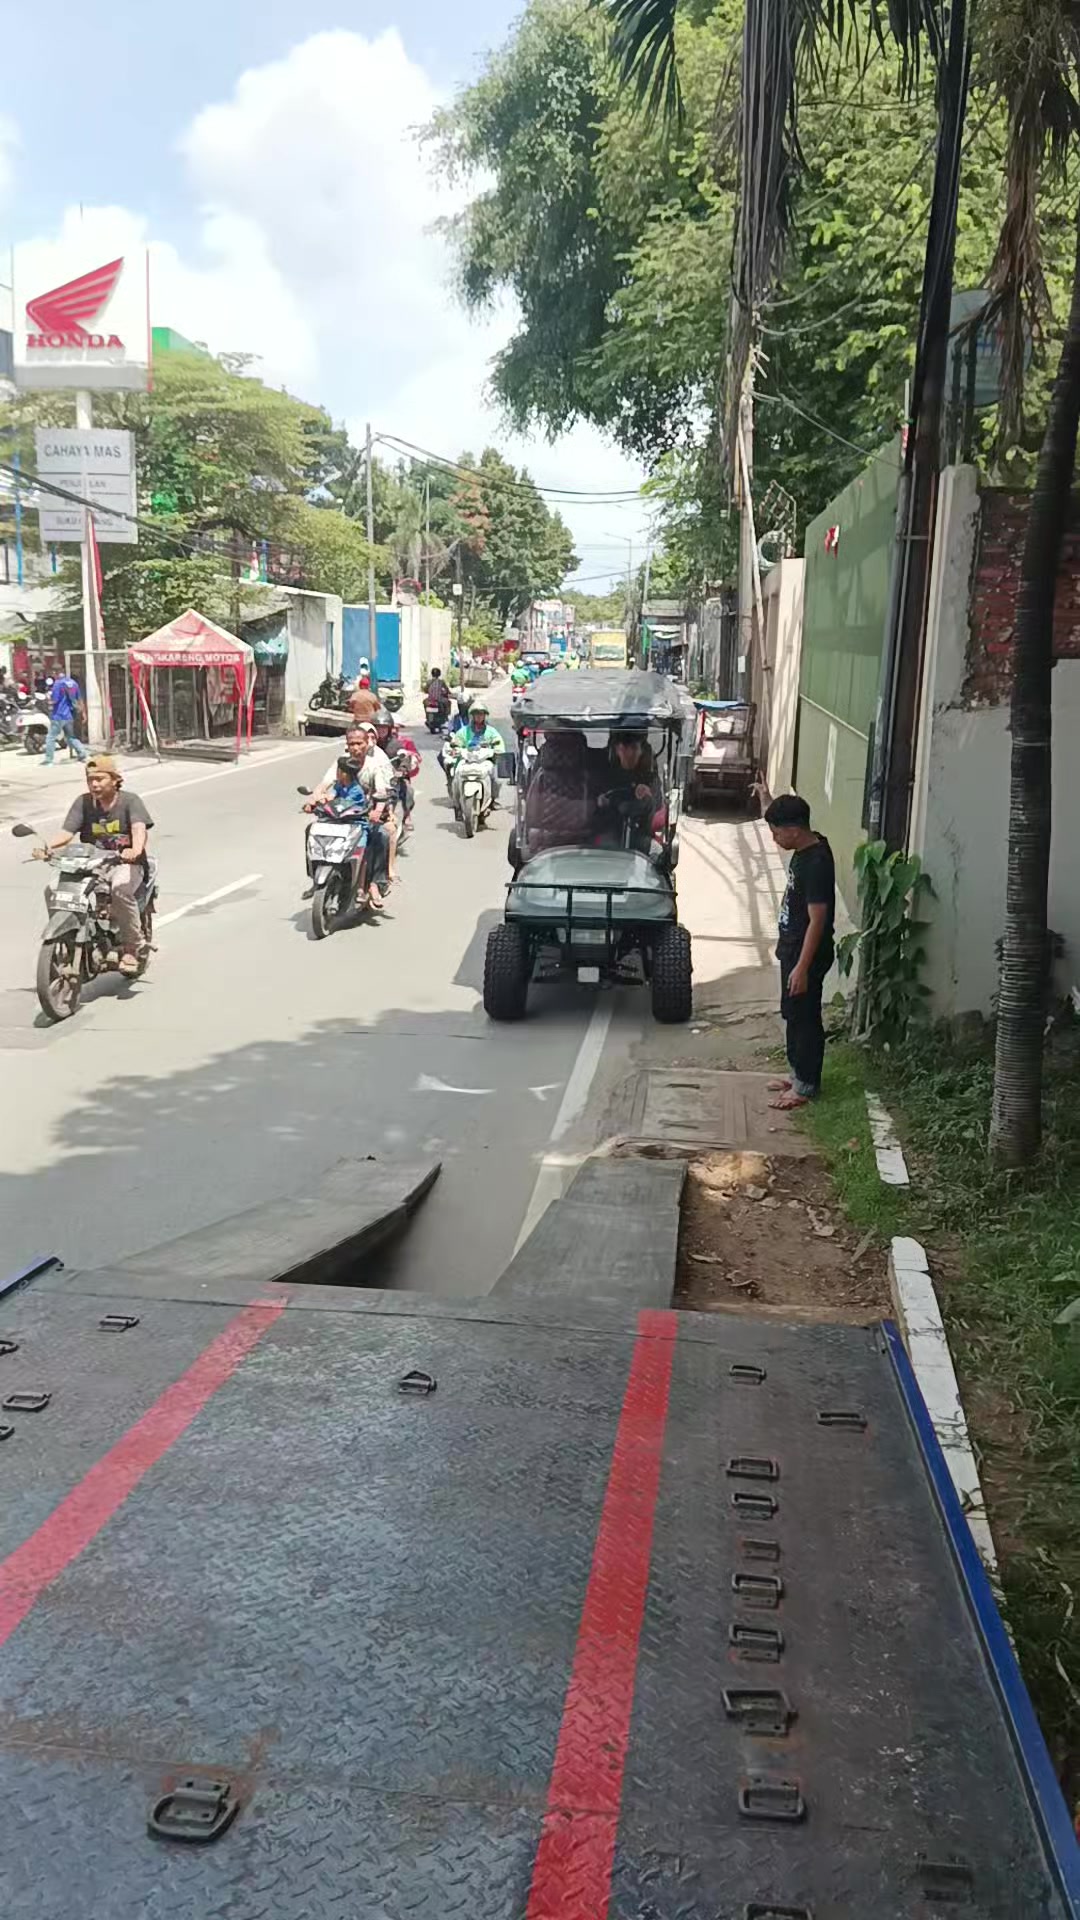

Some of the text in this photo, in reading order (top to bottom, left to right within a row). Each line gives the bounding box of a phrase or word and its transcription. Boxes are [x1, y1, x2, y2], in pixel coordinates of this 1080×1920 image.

[26, 334, 125, 348] HONDA
[94, 445, 122, 458] MAS
[203, 653, 240, 663] MOTOR
